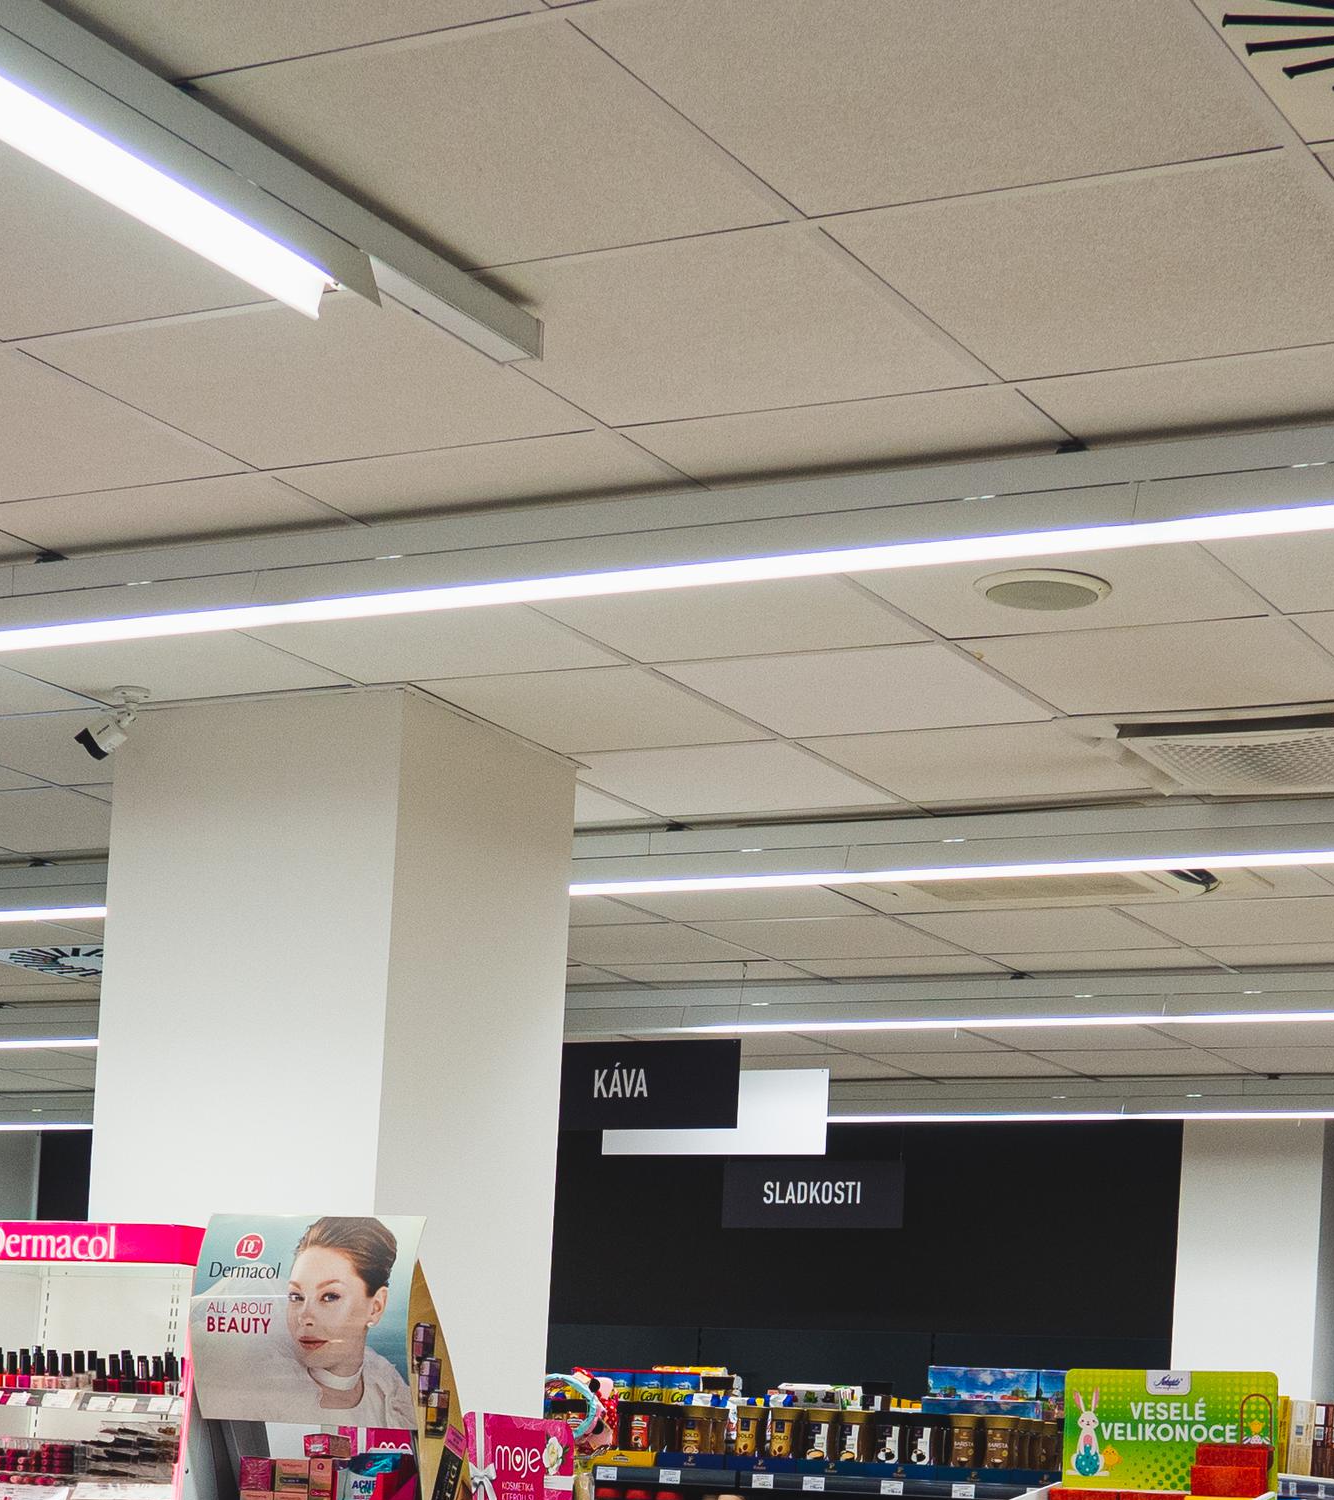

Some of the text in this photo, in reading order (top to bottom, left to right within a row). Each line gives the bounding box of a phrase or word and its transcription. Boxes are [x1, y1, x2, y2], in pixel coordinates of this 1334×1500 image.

[593, 1061, 648, 1100] KÁVA
[762, 1181, 862, 1206] SLADKOSTI
[209, 1261, 282, 1280] Dermacol
[206, 1302, 273, 1315] ALL ABOUT
[206, 1316, 271, 1334] BEAUTY
[1130, 1397, 1207, 1422] VESELÉ
[1101, 1421, 1238, 1444] VELIKONOCE
[495, 1444, 541, 1478] moje
[501, 1482, 535, 1492] KOSMETIKA
